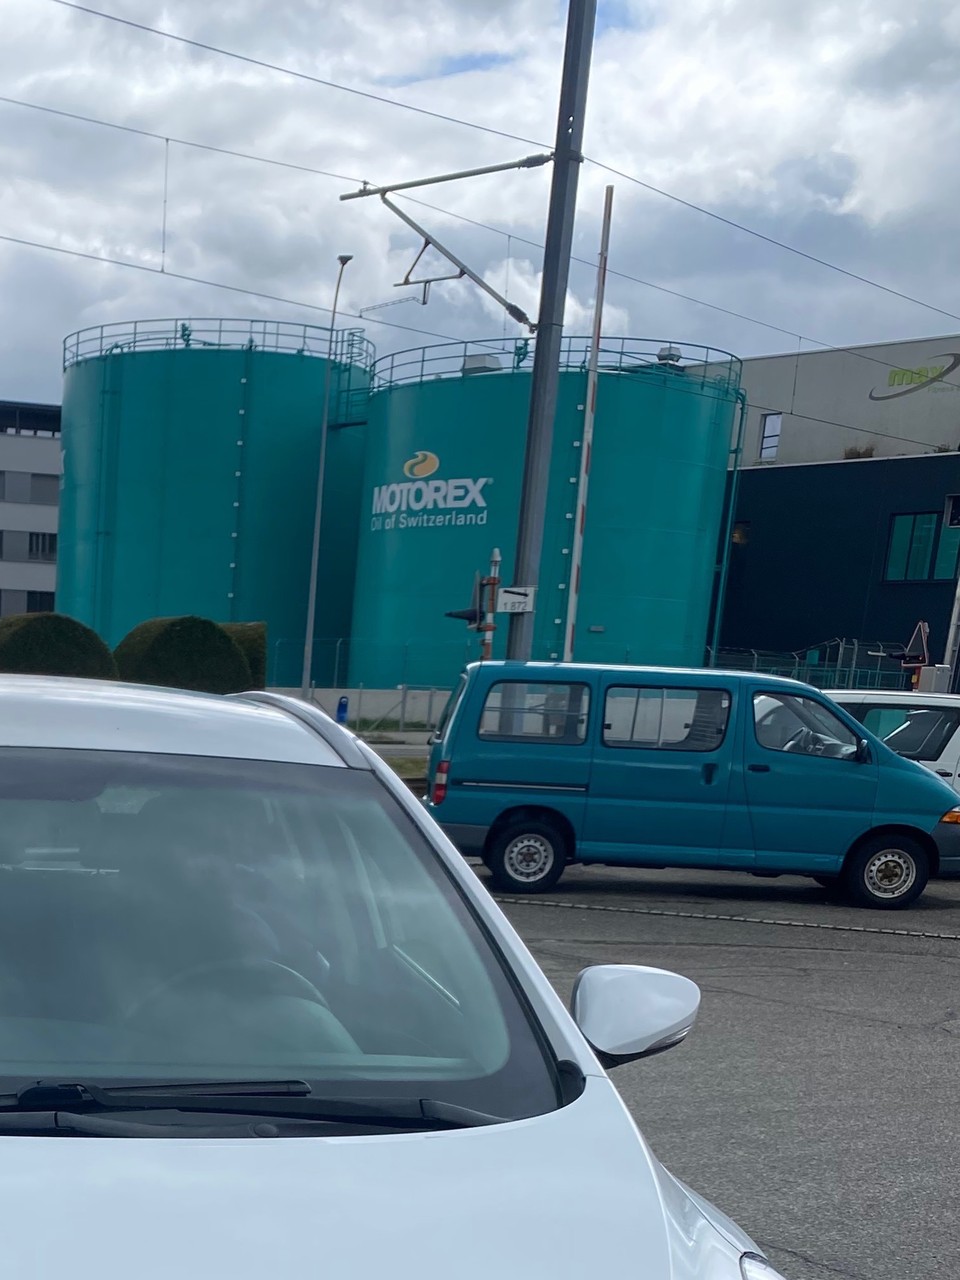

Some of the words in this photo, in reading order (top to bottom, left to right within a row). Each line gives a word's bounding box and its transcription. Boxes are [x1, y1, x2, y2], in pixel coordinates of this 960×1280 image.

[372, 478, 487, 514] MOTOREX
[371, 516, 382, 531] Oil
[385, 515, 395, 529] of
[399, 510, 487, 528] Switzerland
